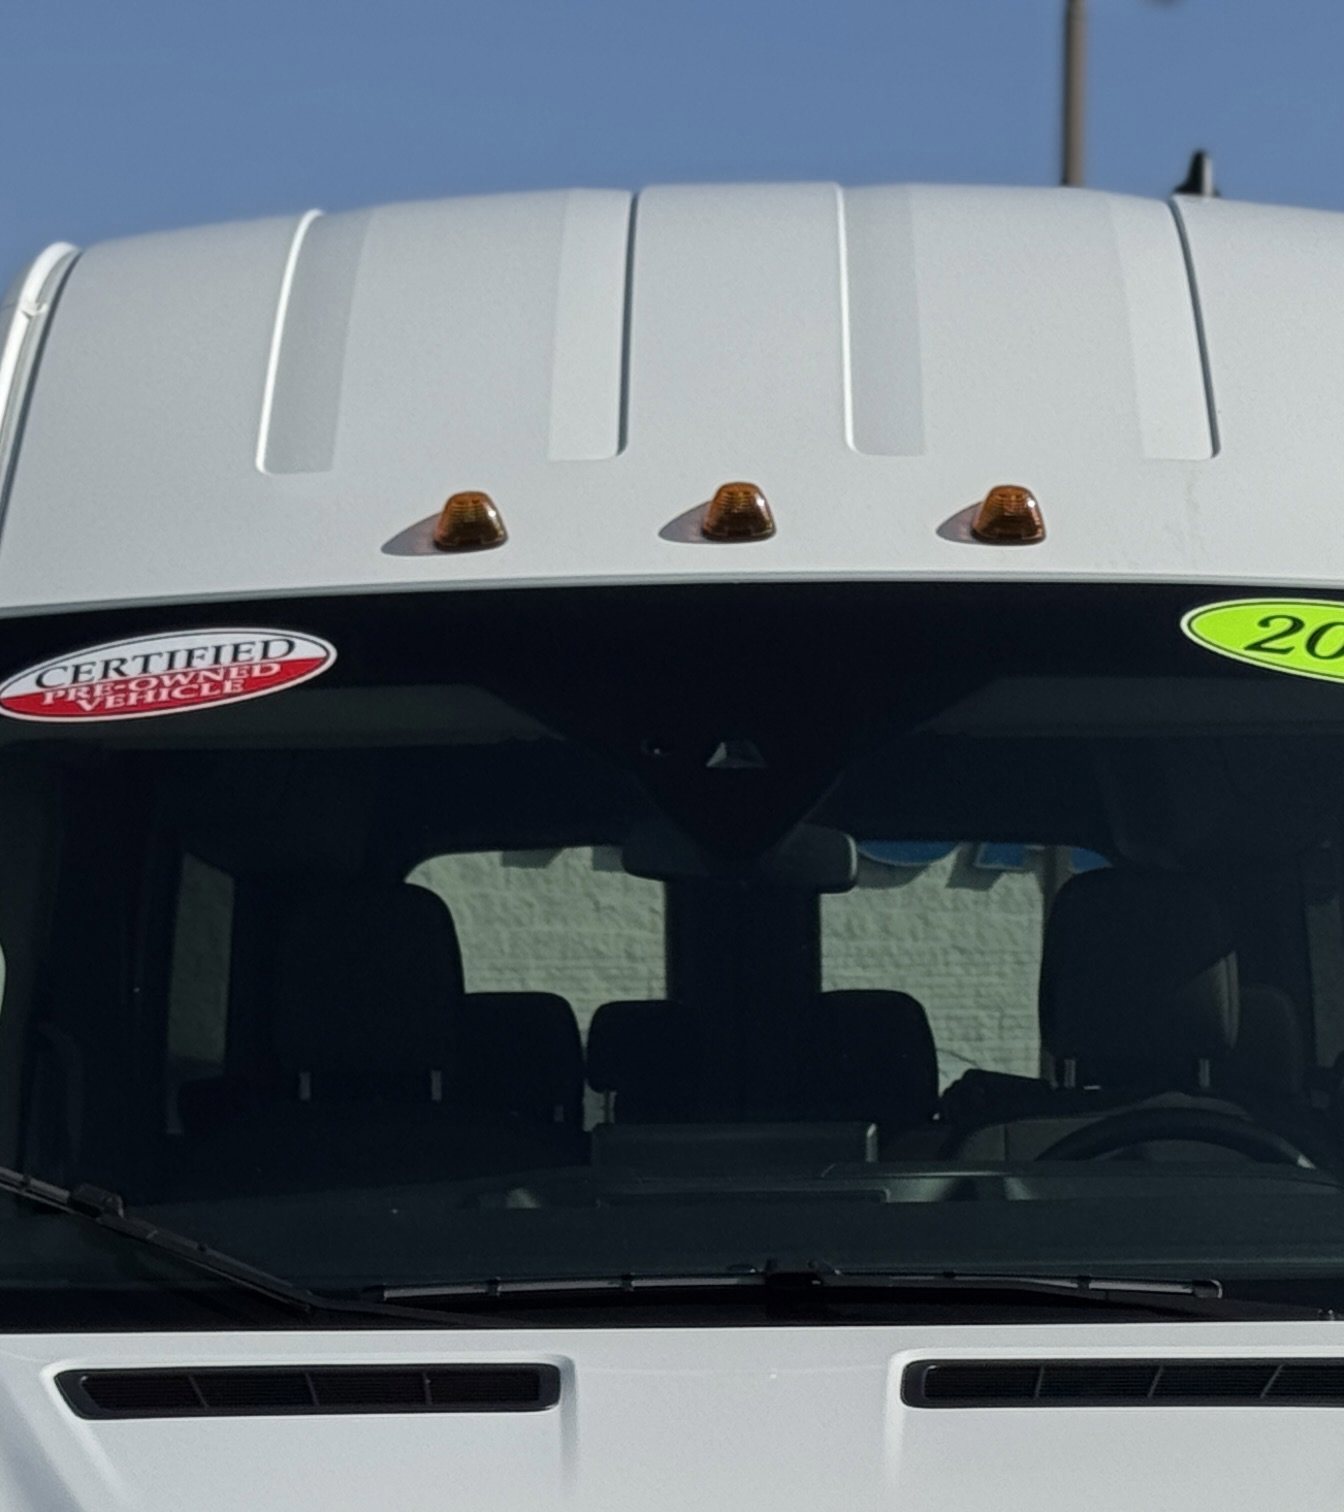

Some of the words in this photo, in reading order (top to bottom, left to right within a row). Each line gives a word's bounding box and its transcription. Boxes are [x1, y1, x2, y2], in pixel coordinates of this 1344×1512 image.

[35, 637, 297, 690] CERTIFIED
[40, 662, 281, 707] PRE-OWNED
[74, 678, 247, 713] VEHICLE
